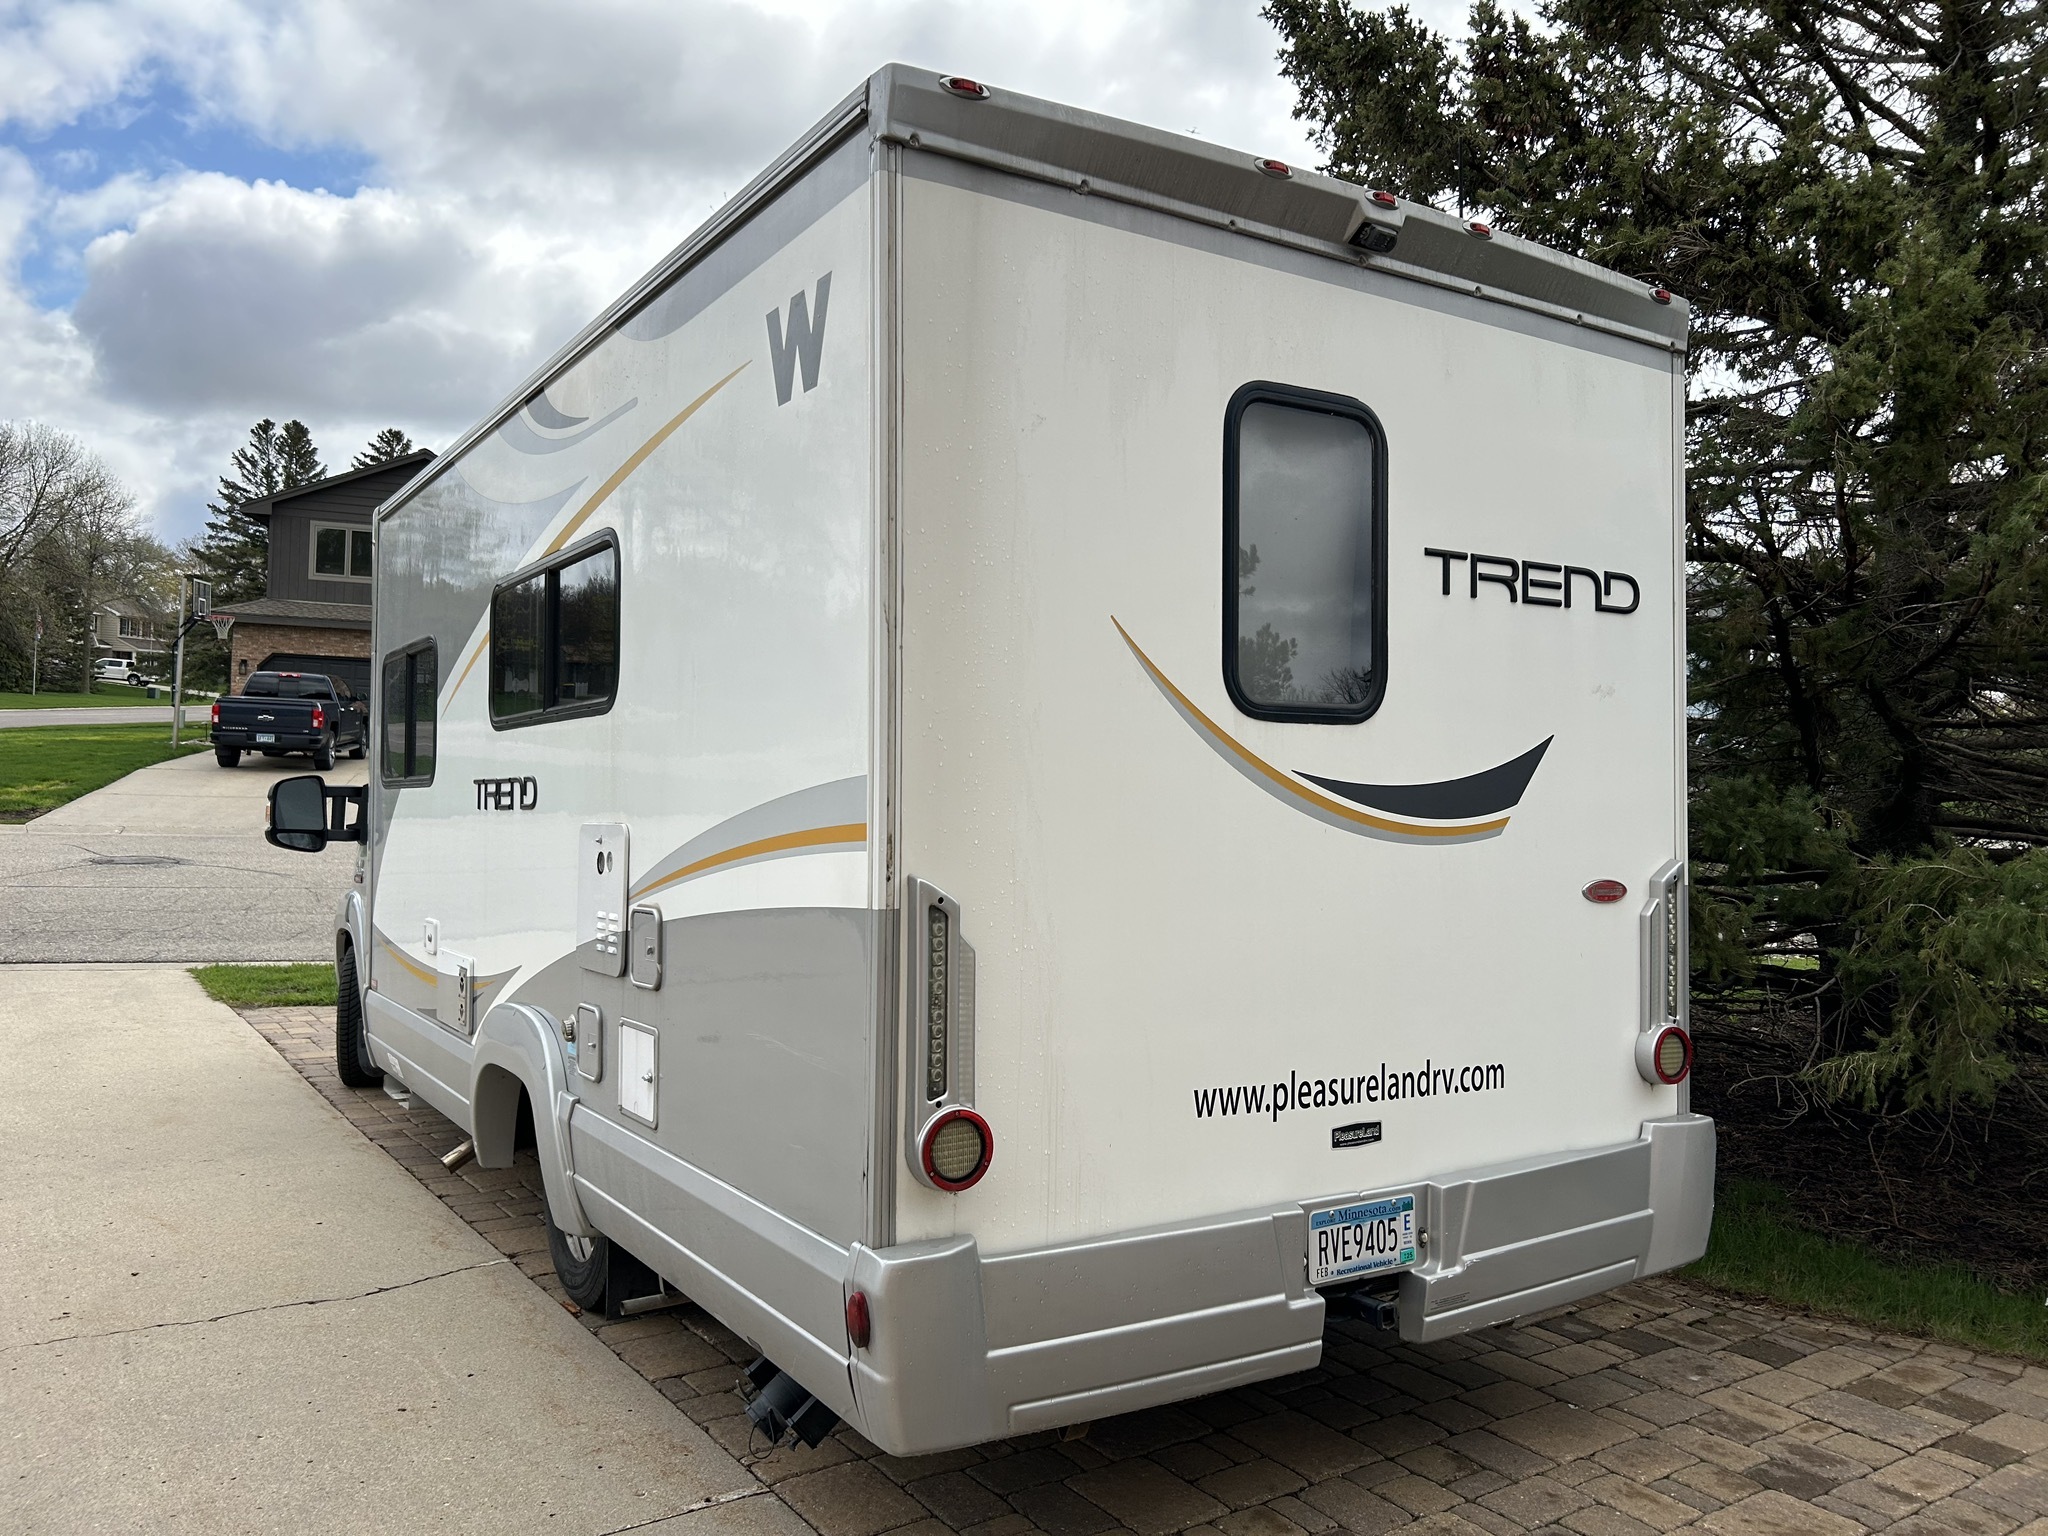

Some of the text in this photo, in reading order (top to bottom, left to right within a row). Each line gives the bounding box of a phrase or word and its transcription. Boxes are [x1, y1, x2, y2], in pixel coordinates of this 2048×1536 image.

[766, 270, 833, 407] W
[1424, 547, 1640, 614] TREND
[473, 776, 537, 810] TREND
[1194, 1059, 1505, 1122] www.pleasurelandrv.com
[1338, 1205, 1387, 1221] Minnesota
[1318, 1217, 1398, 1267] RVE9405
[1316, 1267, 1329, 1279] FEB
[1336, 1258, 1393, 1276] Recreational Vehicle
